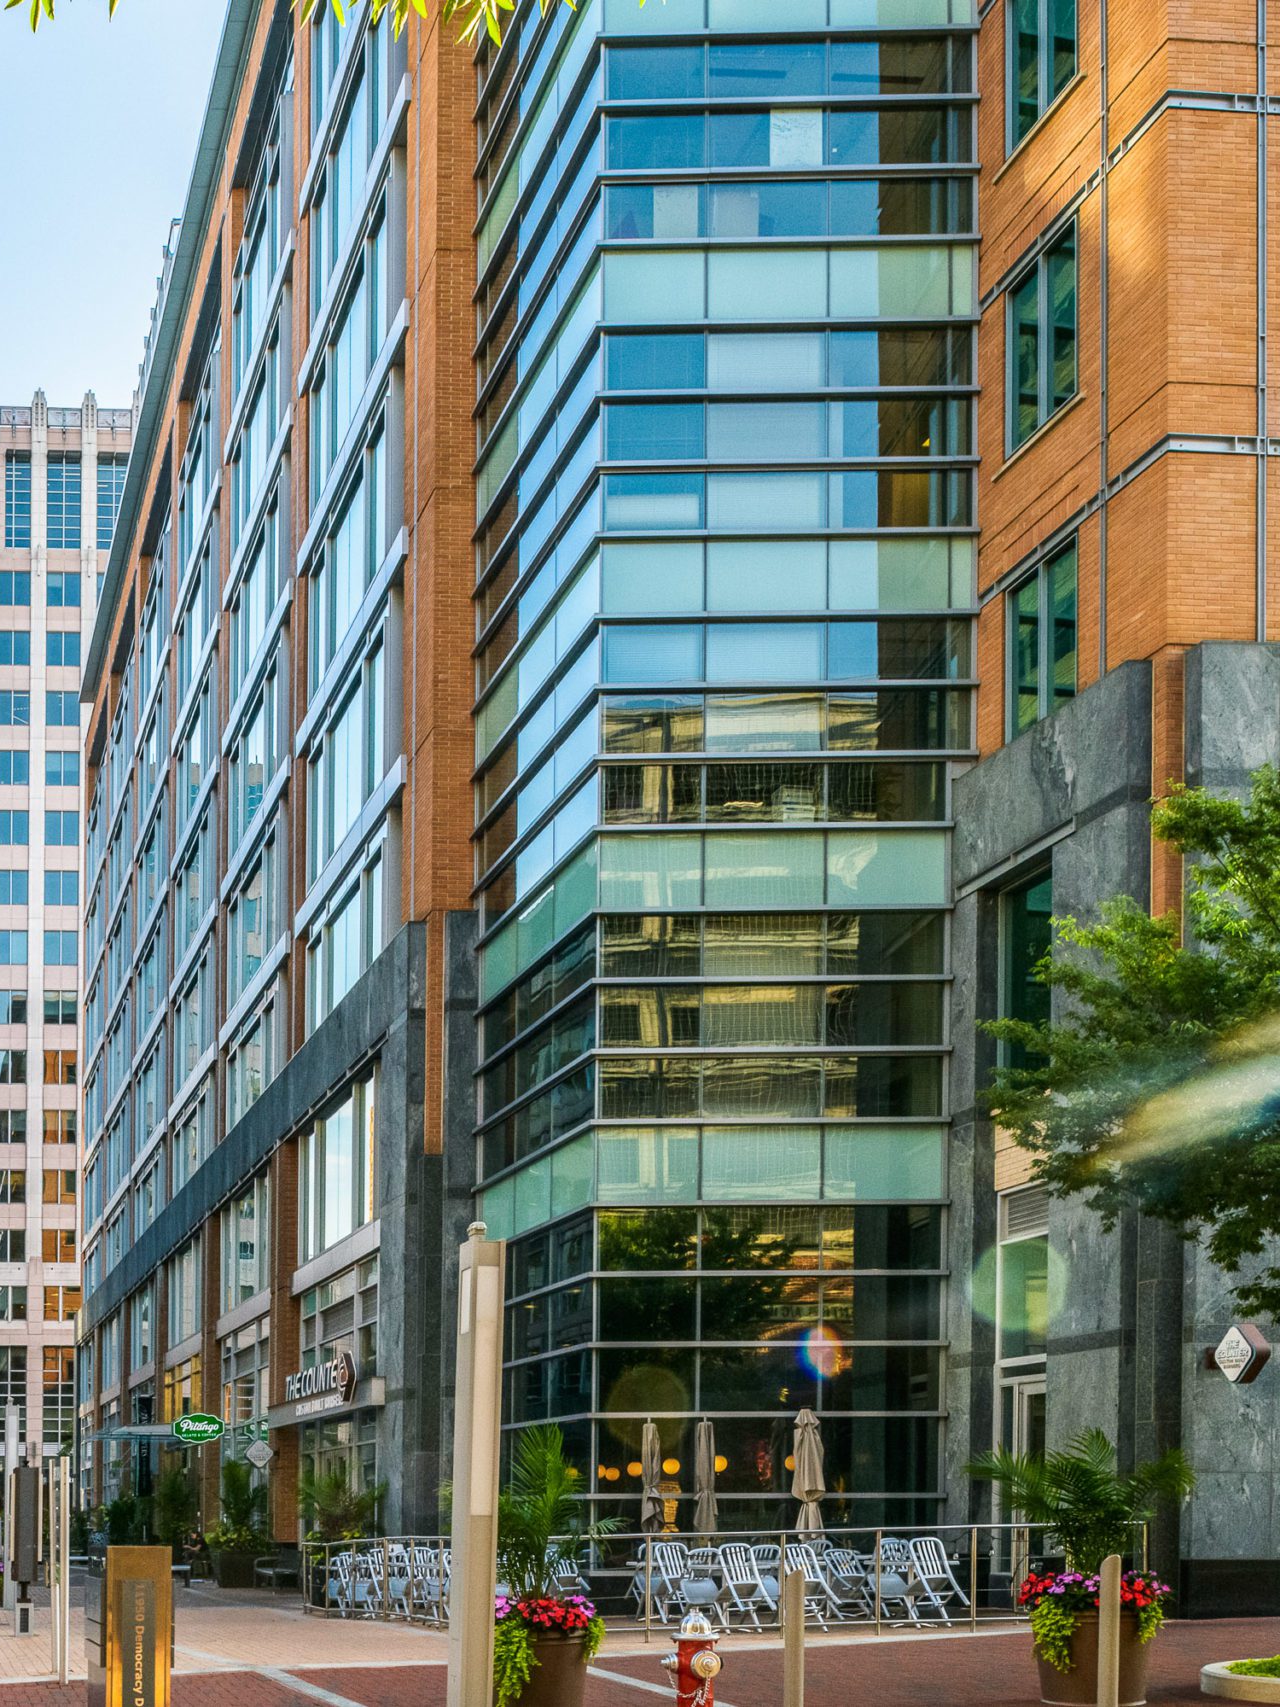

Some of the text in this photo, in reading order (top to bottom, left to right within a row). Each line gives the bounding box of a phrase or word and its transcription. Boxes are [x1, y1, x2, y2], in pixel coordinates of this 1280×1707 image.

[1225, 1340, 1240, 1349] THE
[1217, 1348, 1249, 1359] COUNTER
[286, 1359, 339, 1402] THE COUNTE
[180, 1419, 219, 1433] Pitango
[133, 1626, 145, 1694] Democracy
